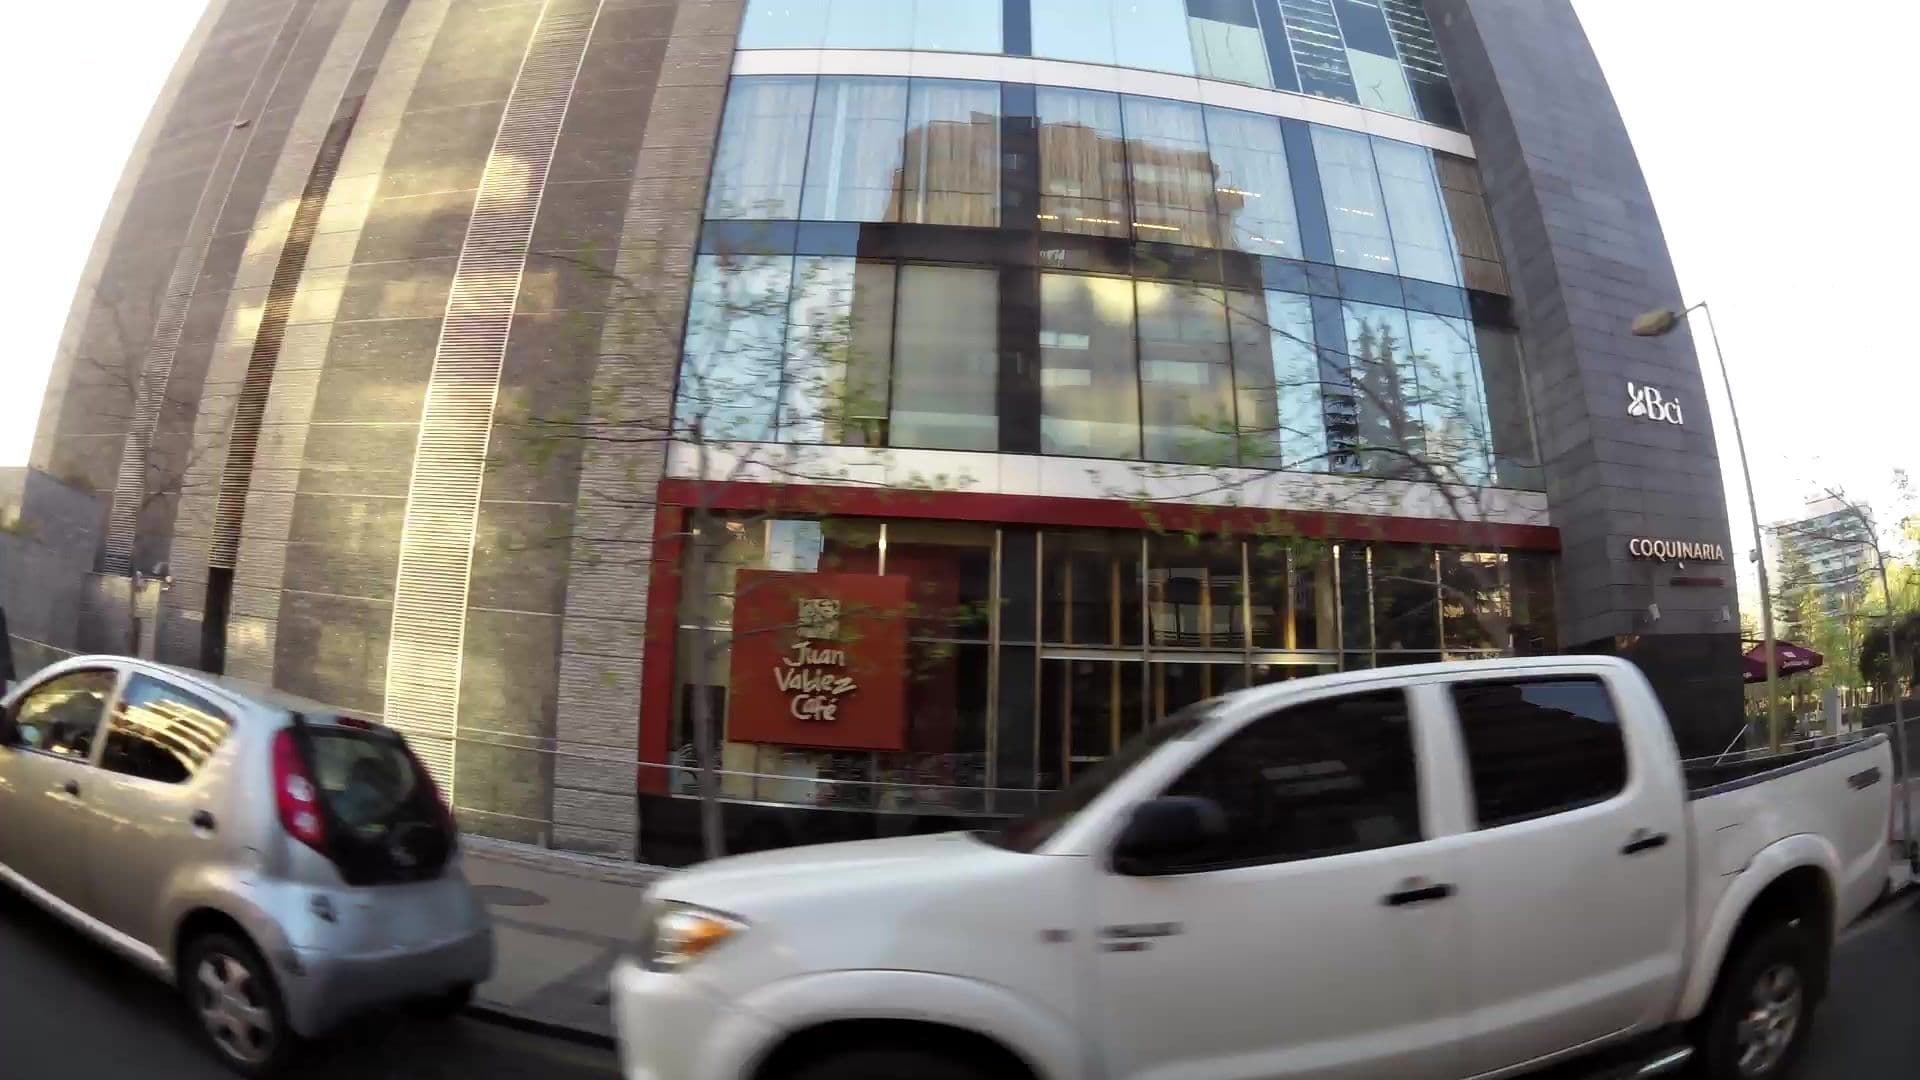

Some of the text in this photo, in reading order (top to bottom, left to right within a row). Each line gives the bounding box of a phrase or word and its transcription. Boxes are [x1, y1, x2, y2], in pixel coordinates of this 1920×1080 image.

[1643, 385, 1684, 425] Bci
[1629, 538, 1725, 562] COQUINARIA
[782, 641, 846, 667] Juan
[791, 694, 838, 721] Café
